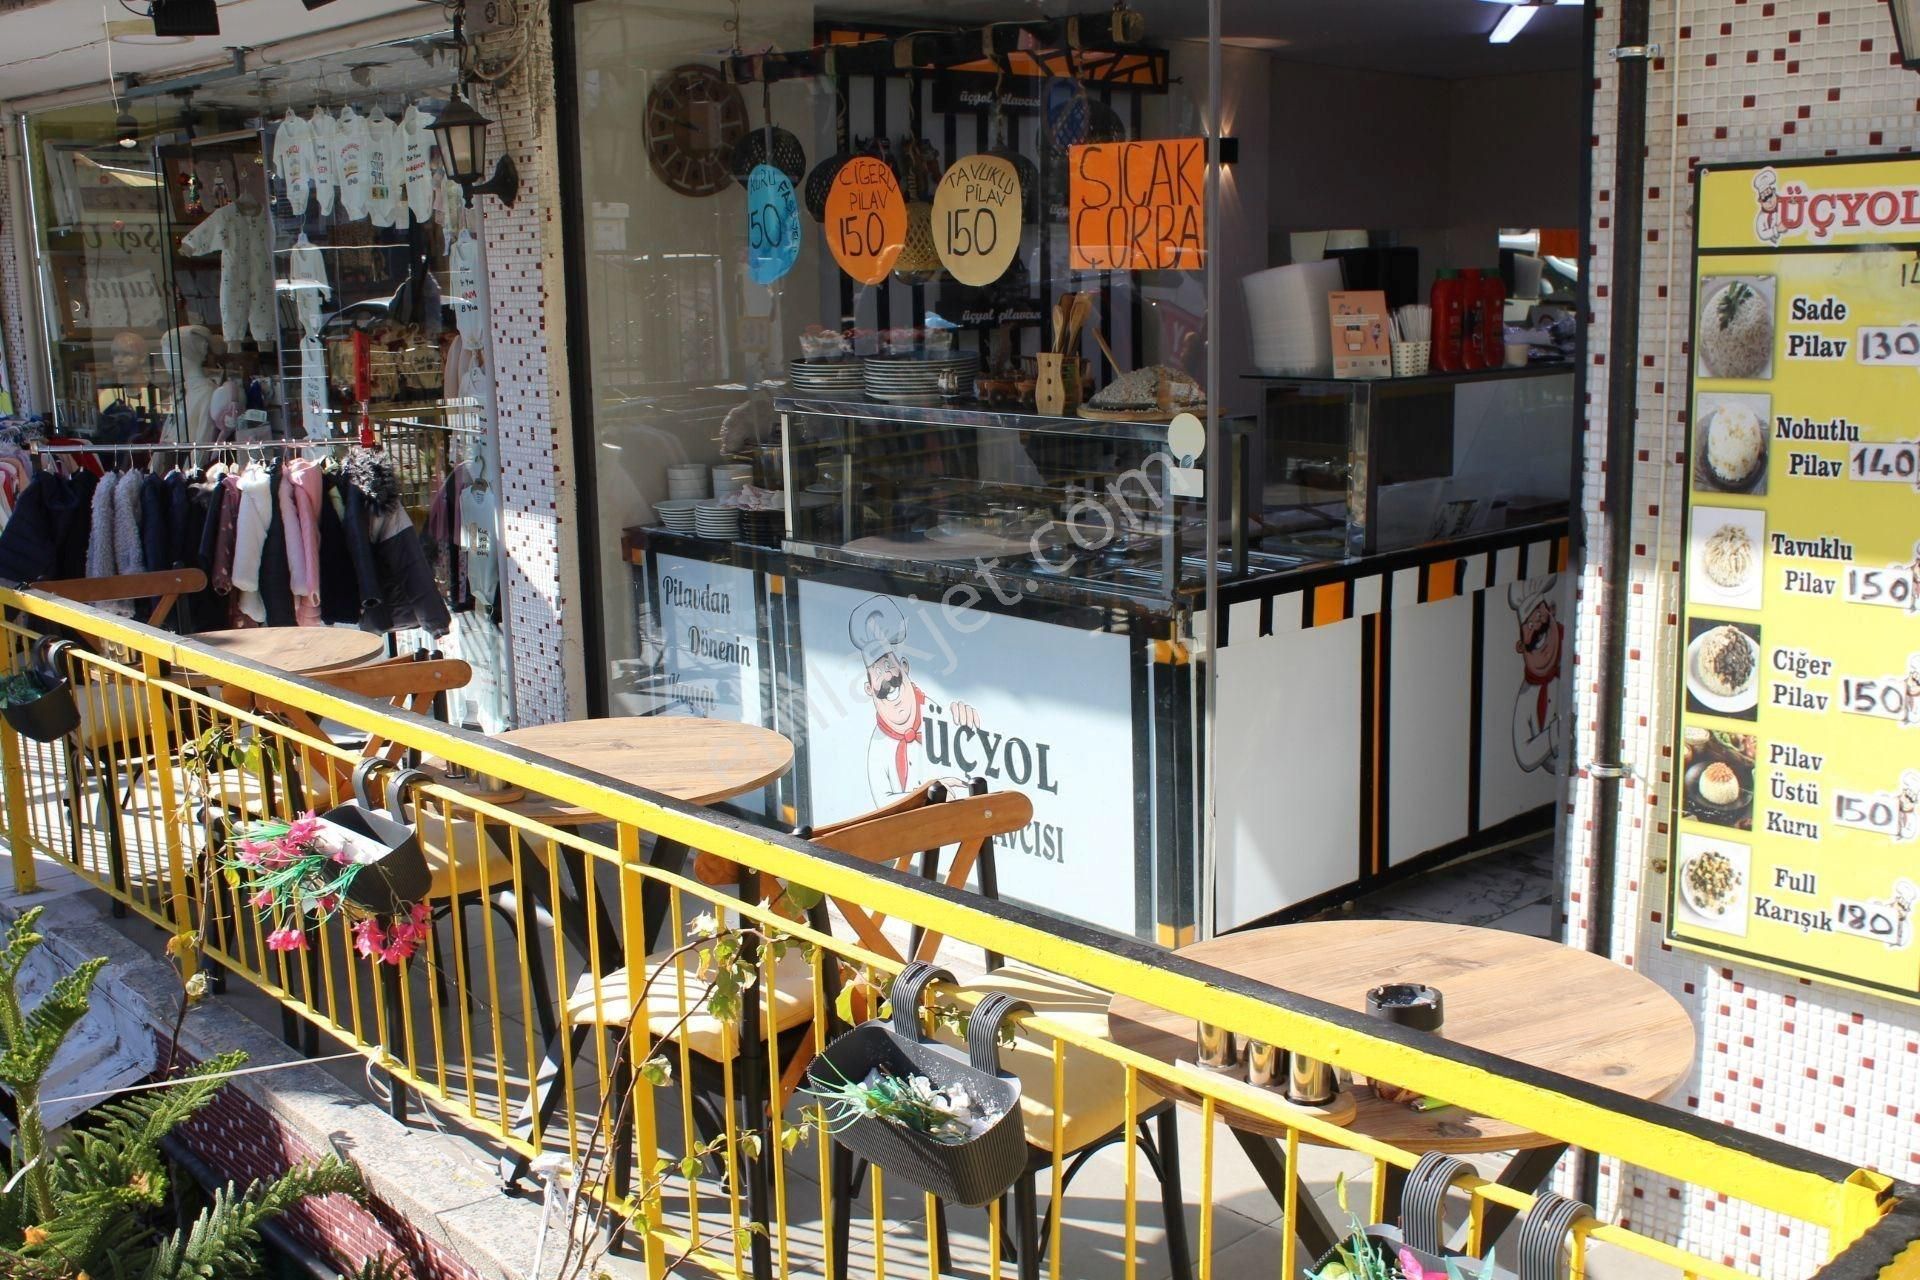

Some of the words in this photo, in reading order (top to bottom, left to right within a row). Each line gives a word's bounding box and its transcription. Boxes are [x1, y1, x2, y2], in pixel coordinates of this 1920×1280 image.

[945, 162, 1014, 195] TAVUKLU
[1080, 143, 1200, 207] SICAK
[966, 184, 1006, 207] PİLAV
[1778, 186, 1920, 237] ÜÇYOL
[840, 212, 884, 256] 150
[948, 208, 996, 256] 150
[1077, 205, 1202, 270] ÇORBA
[1792, 299, 1846, 321] Sade
[1789, 335, 1846, 358] Pilav
[1862, 331, 1919, 361] 130
[1776, 417, 1859, 443] Nohutlu
[1789, 454, 1842, 478] Pilav
[1852, 447, 1915, 477] 140
[1772, 533, 1852, 560] Tavuklu
[663, 575, 730, 615] Pilavdan
[1785, 570, 1835, 594] Pilav
[1849, 569, 1909, 602] 150
[688, 625, 750, 667] Dönenin
[1773, 649, 1831, 678] Ciğer
[1772, 684, 1828, 711] Pilav
[1843, 679, 1903, 714] 150
[923, 704, 1058, 796] ÜÇYOL
[1769, 744, 1822, 771] Pilav
[1771, 772, 1818, 805] Üstü
[1836, 795, 1893, 826] 150
[1767, 811, 1818, 839] Kuru
[1774, 867, 1816, 894] Full
[1754, 896, 1833, 932] Karışık
[1838, 903, 1893, 935] 180
